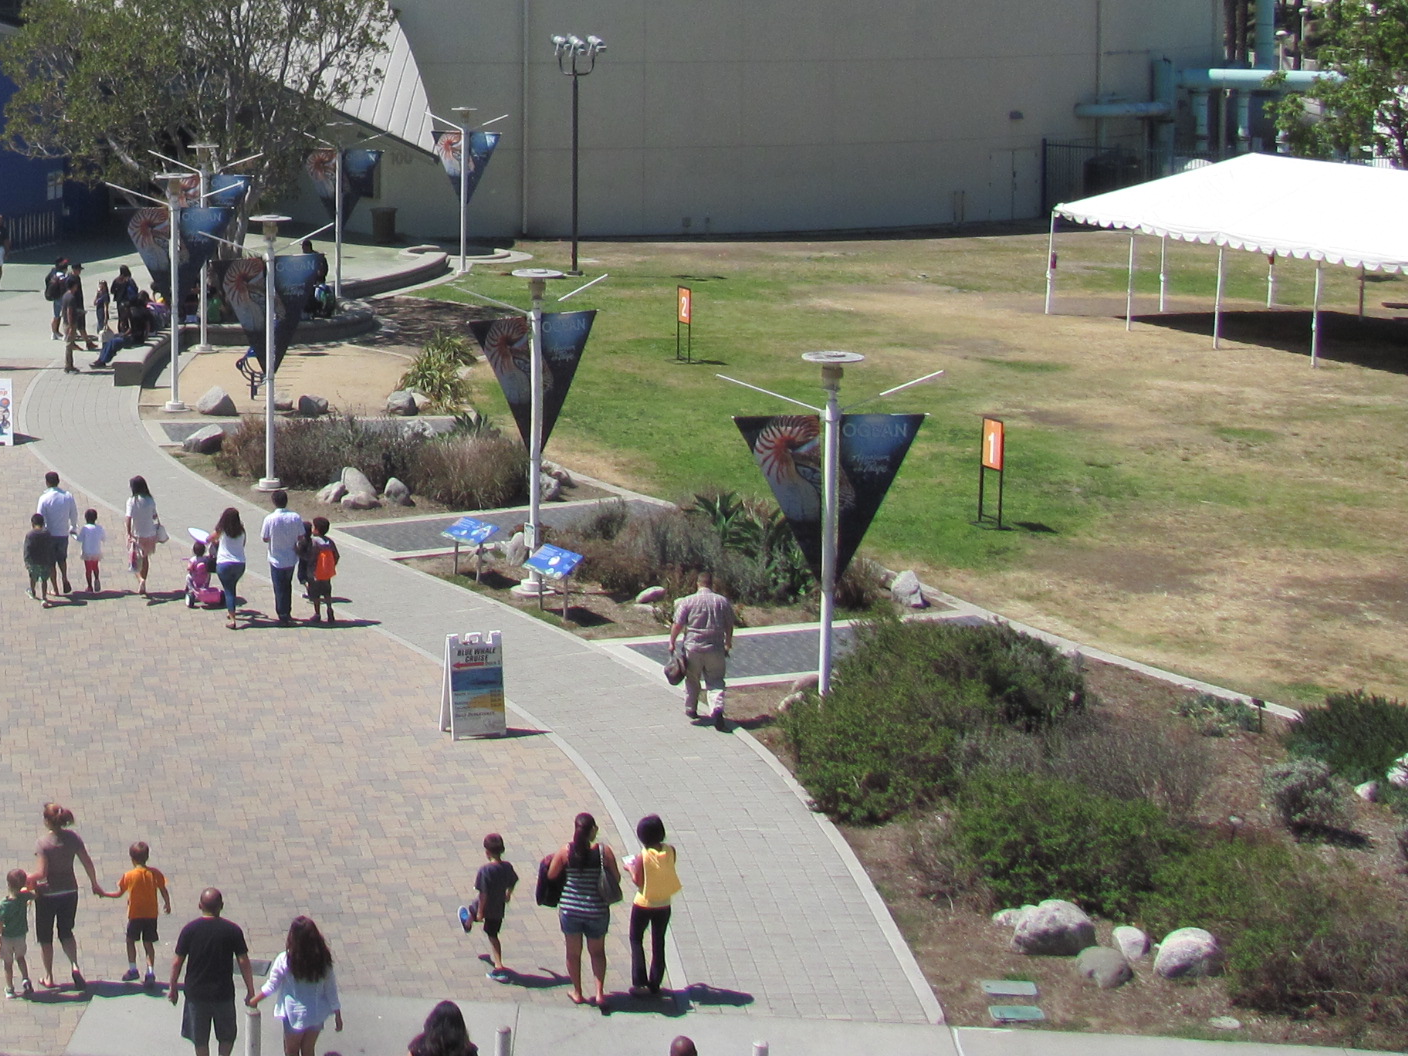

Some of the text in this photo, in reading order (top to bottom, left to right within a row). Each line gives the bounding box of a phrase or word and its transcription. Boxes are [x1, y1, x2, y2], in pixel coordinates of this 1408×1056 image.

[681, 296, 687, 317] 2
[542, 318, 586, 333] OCEAN
[842, 423, 908, 439] OCEAN
[988, 432, 994, 464] 1
[457, 647, 496, 656] BLUE WHALE
[465, 655, 488, 663] CRUISE
